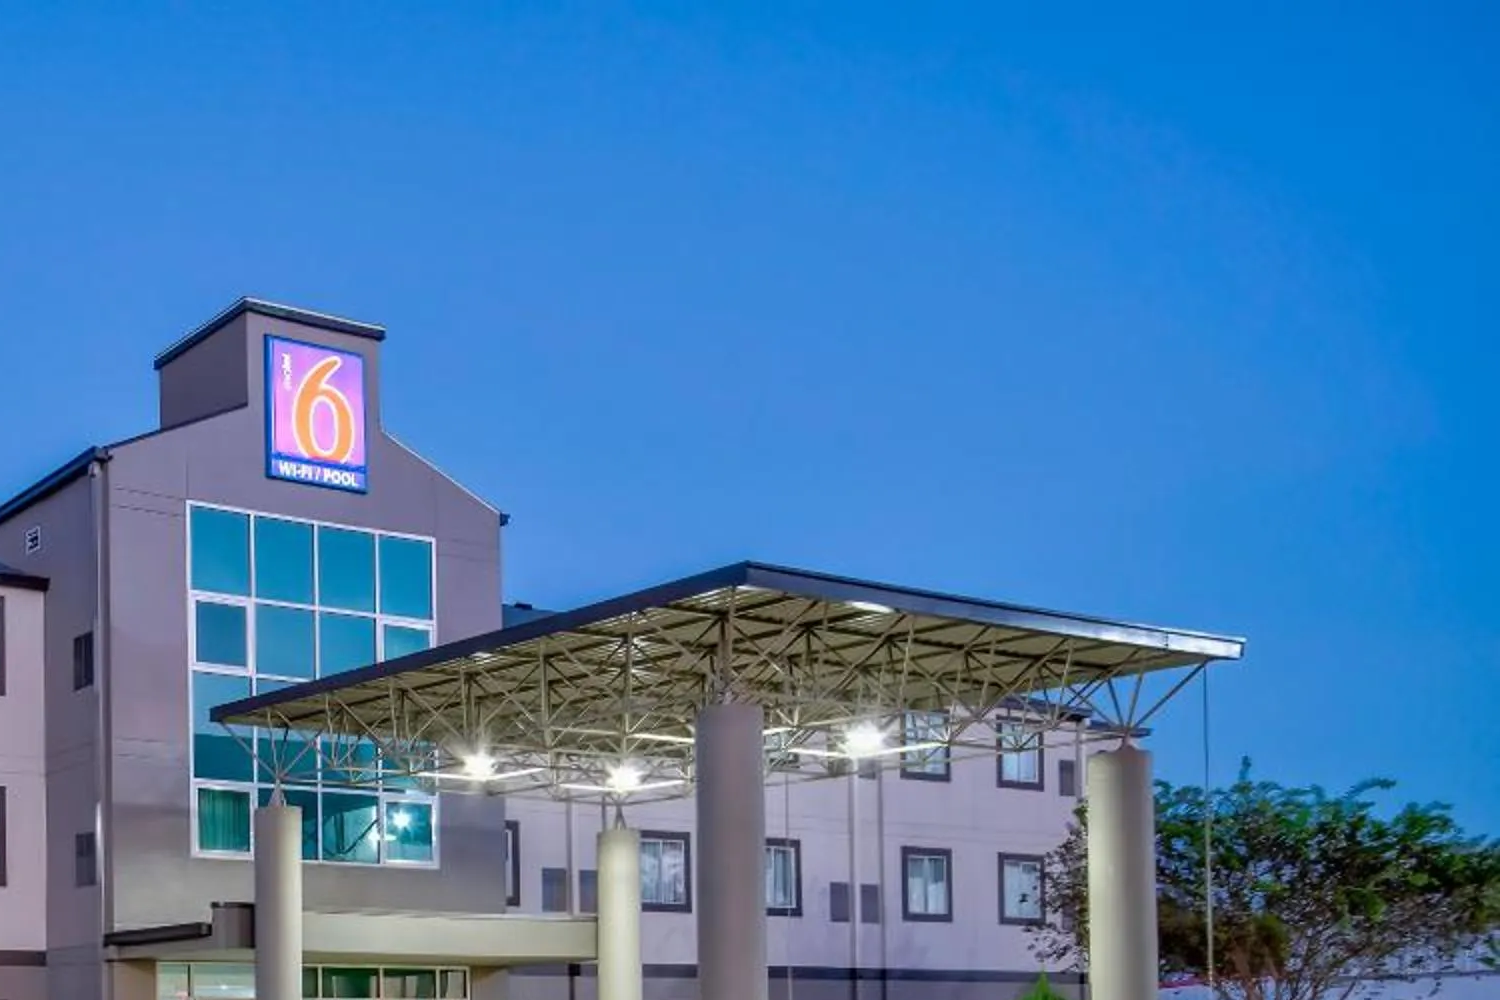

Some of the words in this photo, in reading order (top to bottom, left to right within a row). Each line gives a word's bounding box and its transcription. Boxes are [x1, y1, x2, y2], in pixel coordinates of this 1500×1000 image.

[293, 355, 355, 463] 6
[279, 460, 313, 479] WI-FI
[323, 468, 358, 487] POOL
